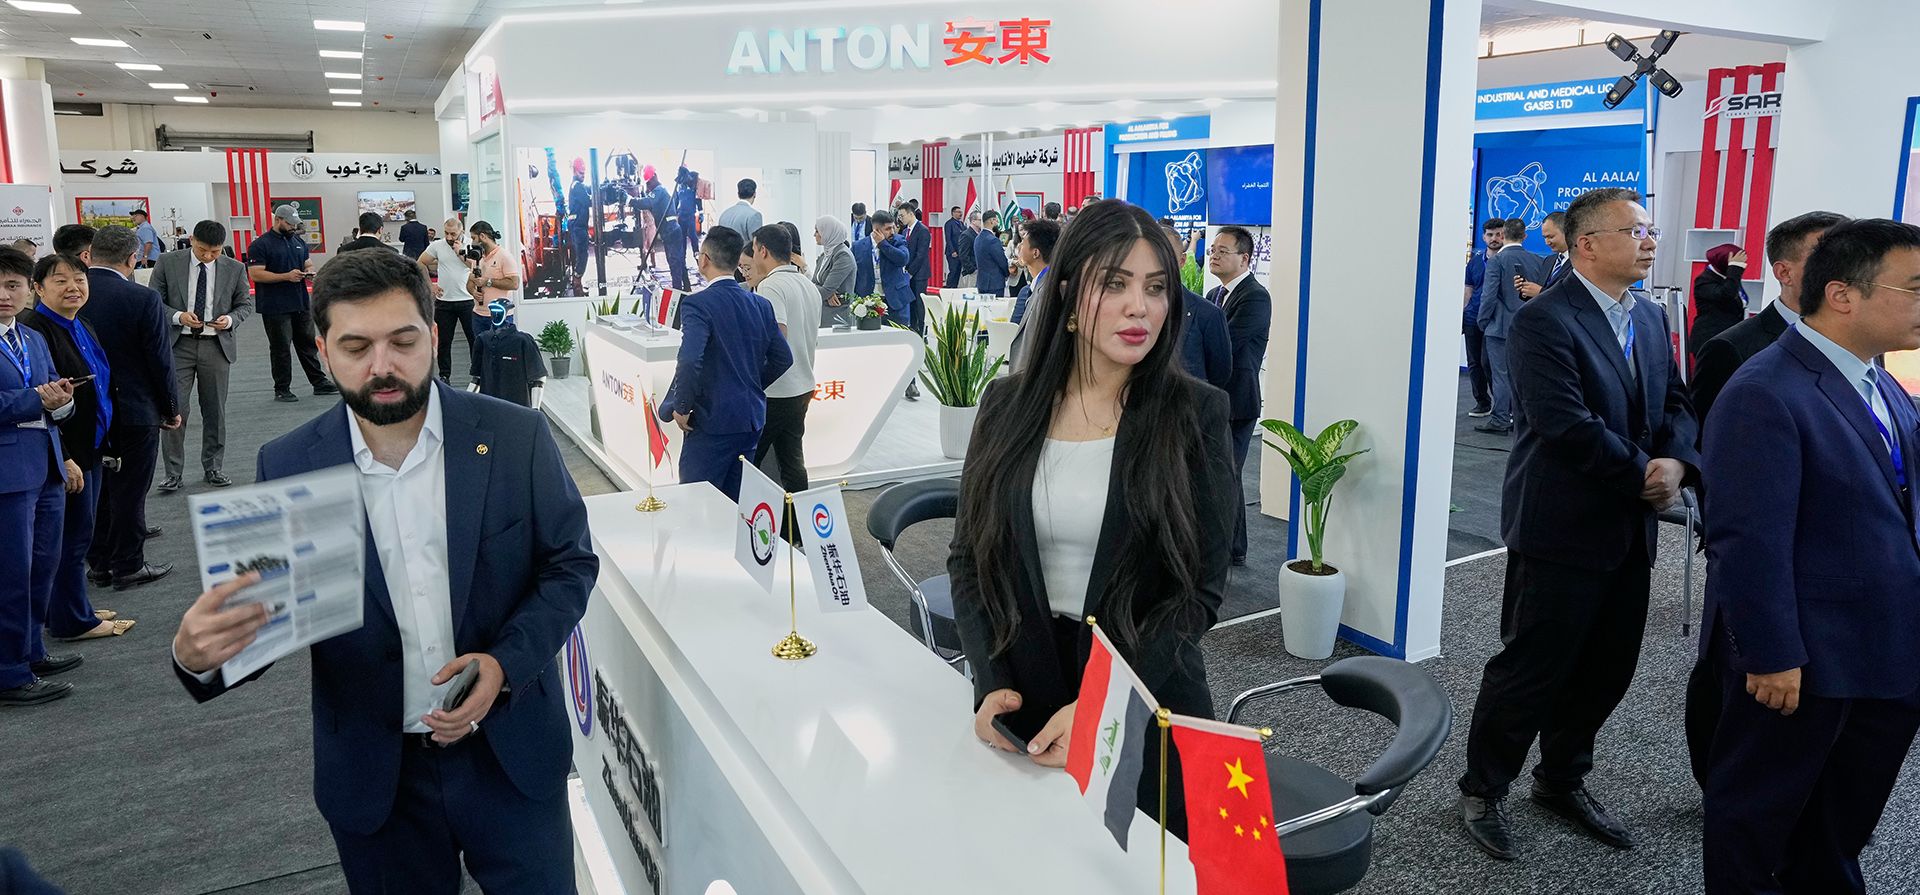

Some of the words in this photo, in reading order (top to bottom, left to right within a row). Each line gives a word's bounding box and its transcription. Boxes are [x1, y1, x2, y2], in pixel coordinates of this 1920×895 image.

[726, 23, 930, 75] ANTON
[943, 16, 1051, 66] 安東
[1477, 92, 1525, 104] INDUSTRIAL
[1527, 89, 1548, 99] AND
[1550, 85, 1595, 98] MEDICAL
[1524, 100, 1554, 112] GASES
[1556, 99, 1573, 109] LTD
[903, 154, 919, 175] شركة
[1016, 150, 1037, 168] خطوط
[1039, 146, 1058, 167] شركة
[326, 161, 388, 178] الجنوب
[1582, 172, 1598, 183] AL
[826, 543, 850, 605] 振华石油
